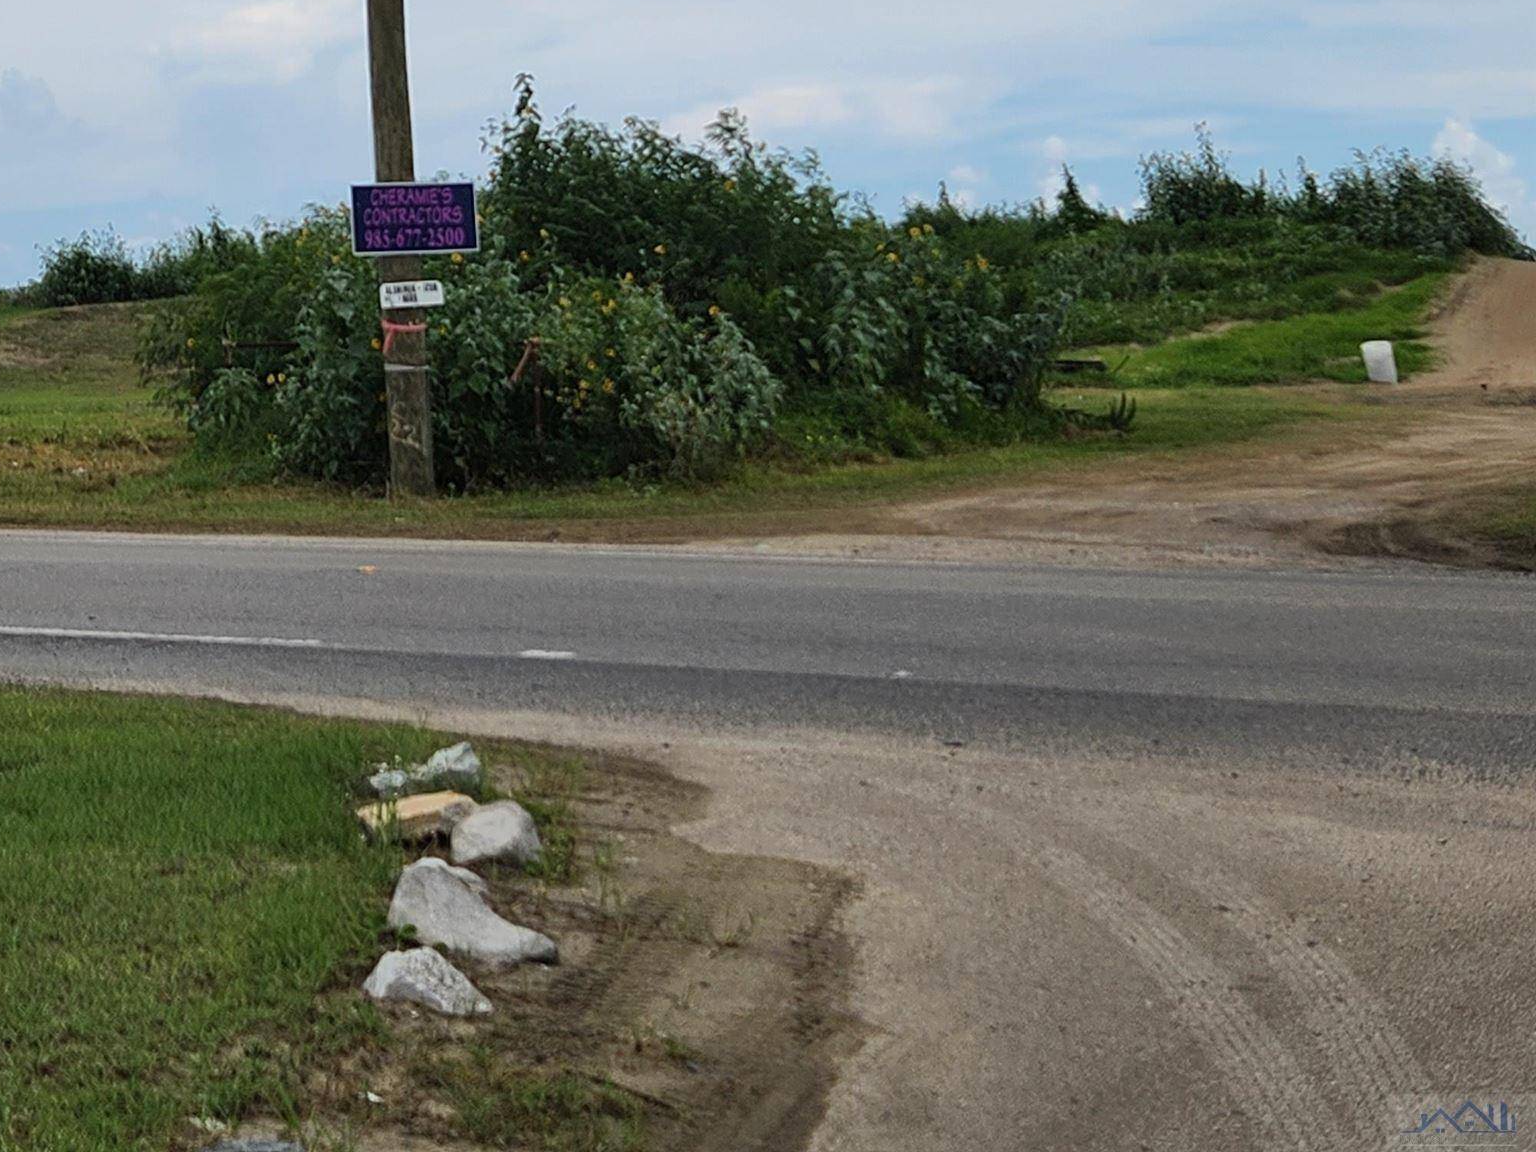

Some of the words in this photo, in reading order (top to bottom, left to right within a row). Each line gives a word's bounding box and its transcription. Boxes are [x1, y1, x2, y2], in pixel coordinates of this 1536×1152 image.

[369, 186, 453, 206] CHERAMIE'S
[363, 206, 463, 225] CONTRACTORS
[364, 227, 465, 248] 985-677-2500
